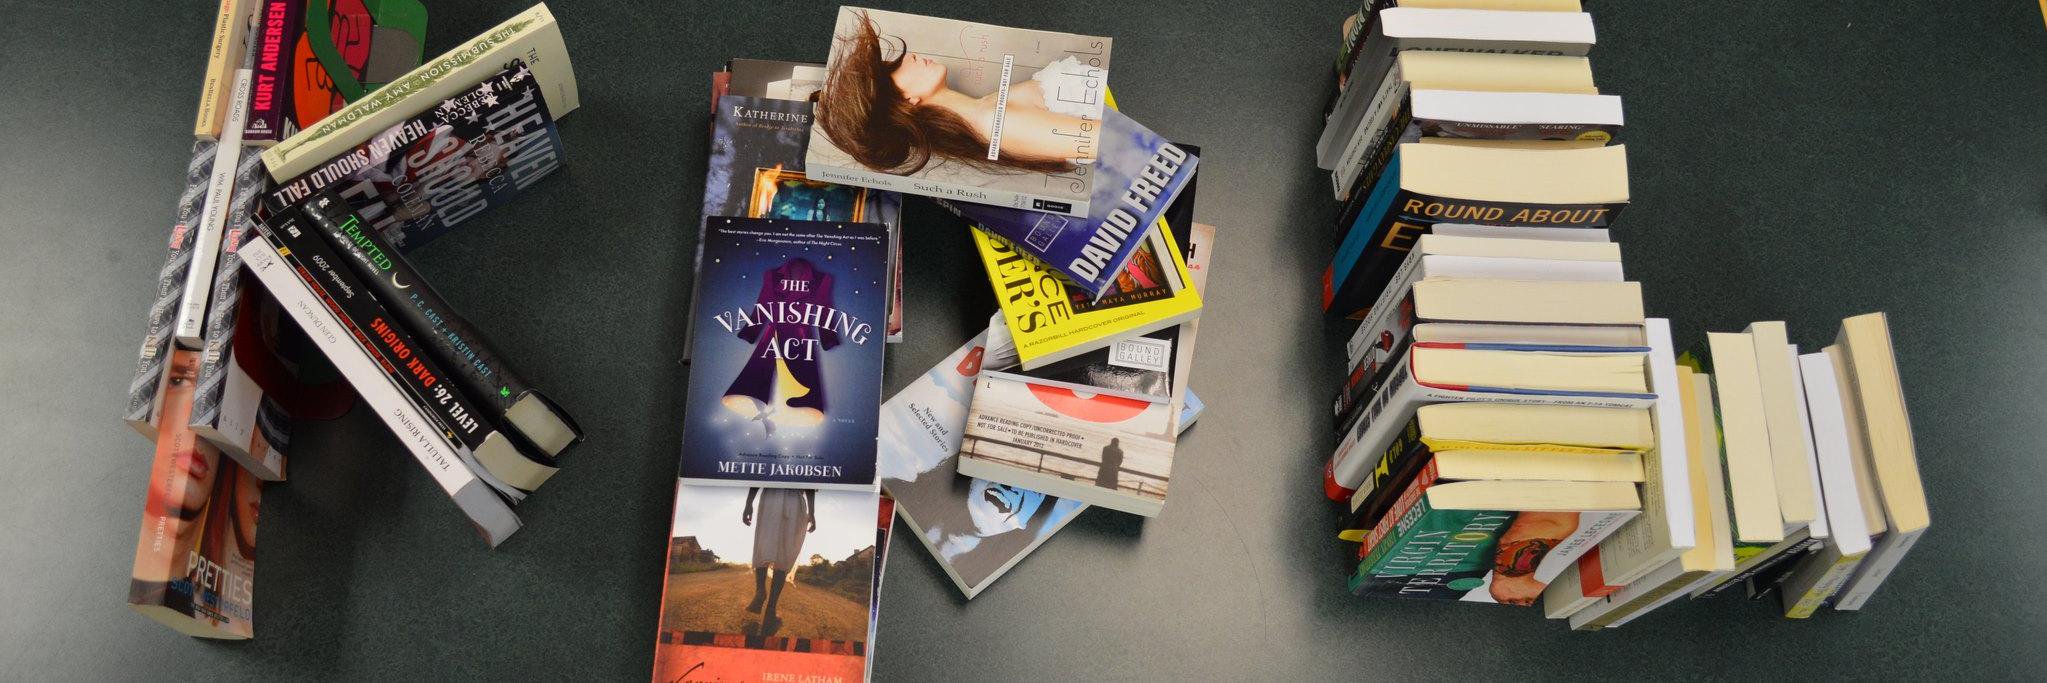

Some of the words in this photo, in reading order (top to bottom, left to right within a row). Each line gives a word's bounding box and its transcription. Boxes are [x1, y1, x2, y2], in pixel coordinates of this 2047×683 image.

[261, 2, 287, 71] ANDERSEN
[495, 27, 517, 42] THE
[420, 38, 496, 82] SUBMISSION
[527, 47, 540, 66] THE
[1057, 40, 1104, 105] Echols
[237, 79, 248, 101] CROSS
[254, 74, 275, 111] KURT
[385, 81, 411, 101] AMY
[232, 101, 243, 122] ROADS
[322, 99, 382, 135] WALDMAN
[733, 105, 808, 123] KATHERINE
[368, 119, 428, 160] HEAVEN
[485, 97, 560, 190] HEAVEN
[1044, 114, 1093, 193] Jennifer
[311, 149, 371, 189] SHOULD
[407, 133, 488, 228] SHOULD
[821, 170, 859, 184] Jennifer
[860, 176, 893, 188] Echols
[913, 182, 944, 194] Such
[956, 189, 988, 200] Rush
[273, 180, 312, 207] FALL
[207, 207, 217, 231] YOUNG
[1068, 208, 1138, 283] DAVID
[1121, 142, 1187, 214] FREED
[1403, 198, 1504, 221] ROUND
[1510, 208, 1610, 224] ABOUT
[339, 214, 392, 271] TEMPTED
[312, 255, 330, 272] 2009
[328, 270, 355, 299] September
[780, 279, 810, 293] THE
[1102, 296, 1125, 305] MAYA
[1131, 288, 1167, 301] MURRAY
[370, 316, 412, 360] ORIGINS
[713, 301, 872, 346] VANISHING
[1029, 334, 1068, 348] RAZORBILL
[1068, 320, 1112, 338] HARDCOVER
[1112, 311, 1146, 324] ORIGINAL
[424, 308, 443, 327] CAST
[447, 330, 475, 361] KRISTIN
[474, 358, 493, 378] CAST
[761, 337, 819, 362] ACT
[1119, 352, 1160, 364] GALLEY
[1120, 342, 1161, 356] BOUND
[406, 356, 437, 388] DARK
[433, 383, 454, 405] 26:
[393, 408, 421, 440] RISING
[449, 401, 480, 434] LEVEL
[908, 402, 932, 436] Selected
[929, 428, 949, 452] Stories
[923, 406, 936, 424] New
[936, 422, 949, 436] and
[978, 414, 1000, 424] ADVANCE
[999, 416, 1020, 428] READING
[987, 424, 997, 432] FOR
[1025, 430, 1049, 442] PUBLISHED
[1056, 436, 1083, 449] HARDCOVER
[1012, 437, 1033, 447] JANUARY
[419, 435, 450, 471] TALULLA
[718, 461, 767, 474] METTE
[768, 464, 842, 478] JAKOBSEN
[1398, 499, 1426, 537] LECESNE
[154, 516, 167, 553] PRETTIES
[1374, 530, 1451, 578] VIRGIN
[1399, 513, 1511, 595] TERRITORY
[186, 551, 252, 605] PRETTIES
[762, 672, 795, 683] IRENE
[799, 674, 843, 683] LATHAM
